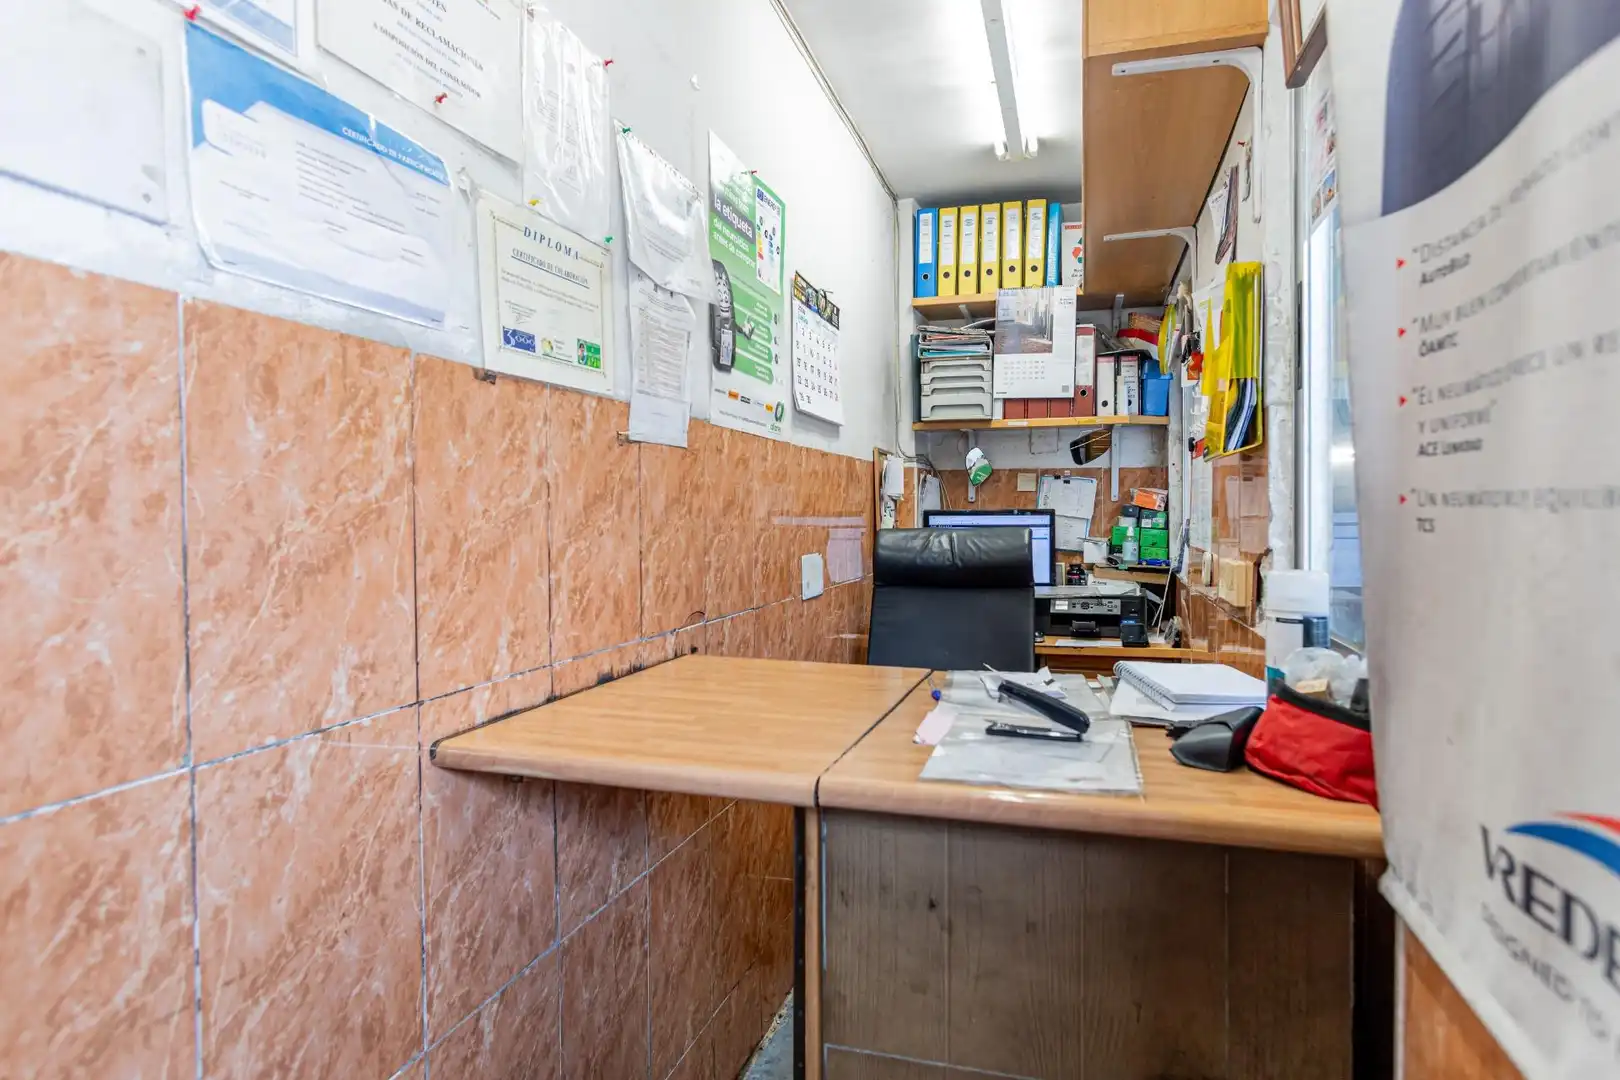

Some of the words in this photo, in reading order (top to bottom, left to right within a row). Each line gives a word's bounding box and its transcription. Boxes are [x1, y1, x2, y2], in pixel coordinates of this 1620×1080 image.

[415, 17, 484, 71] RECLAMACIONES
[714, 194, 721, 211] la
[722, 204, 753, 239] etiqueta
[523, 226, 579, 260] DIPLOMA
[1416, 517, 1435, 534] TCS
